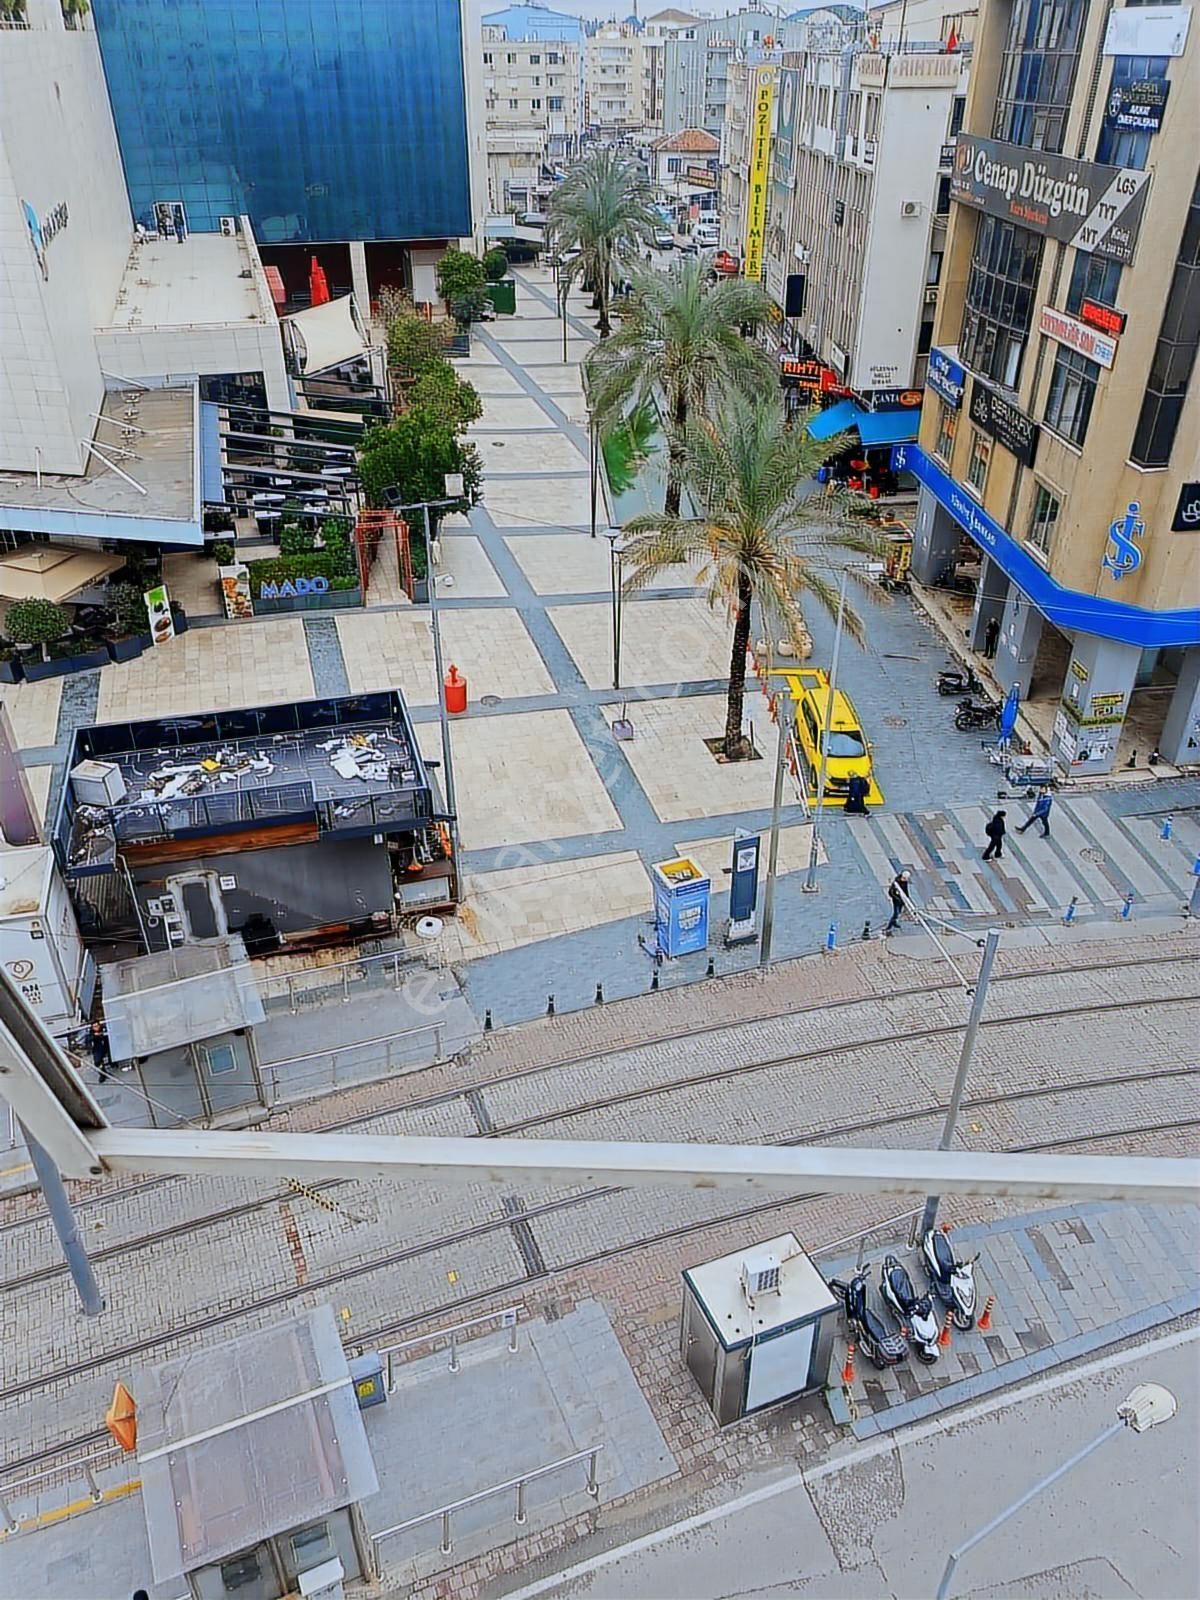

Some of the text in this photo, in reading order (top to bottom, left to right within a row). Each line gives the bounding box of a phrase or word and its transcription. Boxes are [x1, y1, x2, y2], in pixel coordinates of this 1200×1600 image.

[975, 150, 1018, 200] Cenap
[1020, 162, 1089, 217] Düzgün
[1116, 176, 1137, 195] LGS
[1098, 202, 1117, 220] TYT
[1080, 227, 1098, 245] AYT
[261, 576, 329, 599] MADO
